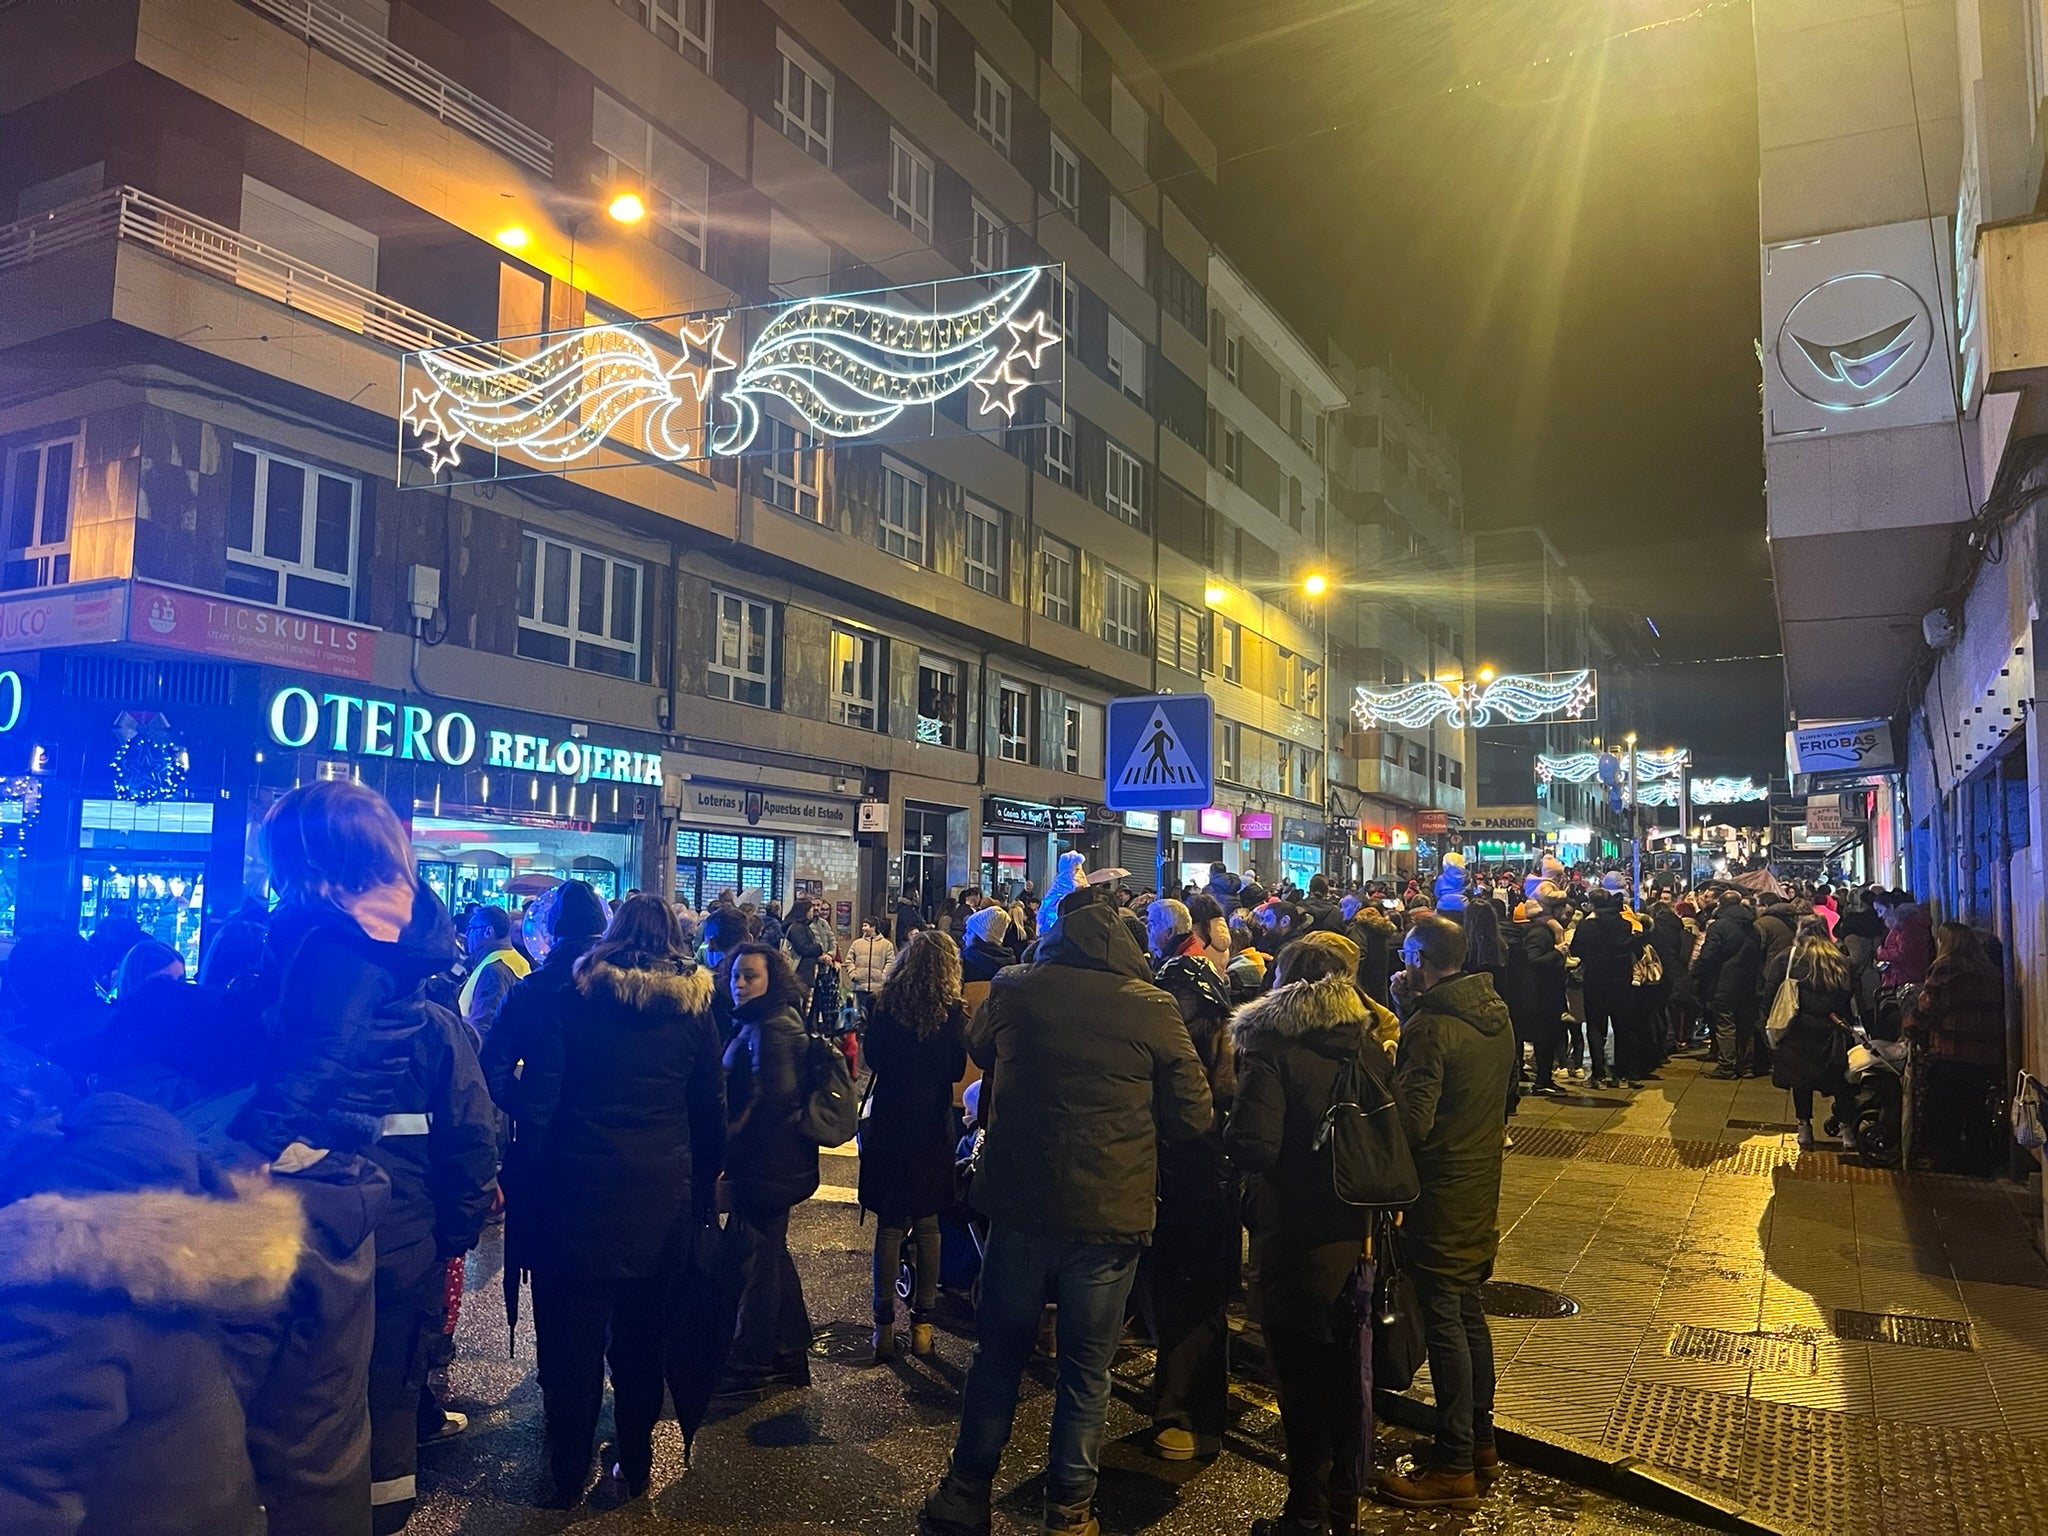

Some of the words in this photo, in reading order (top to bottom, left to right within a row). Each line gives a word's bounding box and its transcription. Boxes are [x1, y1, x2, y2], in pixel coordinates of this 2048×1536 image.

[205, 602, 358, 651] TICSKULLS
[270, 687, 476, 766] OTERO
[489, 730, 664, 787] RELOJERIA
[1800, 734, 1877, 753] FRIOBAS
[698, 792, 736, 809] Loterías
[735, 800, 744, 812] y
[763, 801, 801, 817] Apuestas
[803, 805, 816, 818] del
[818, 807, 843, 821] Estado
[1485, 817, 1535, 828] PARKING
